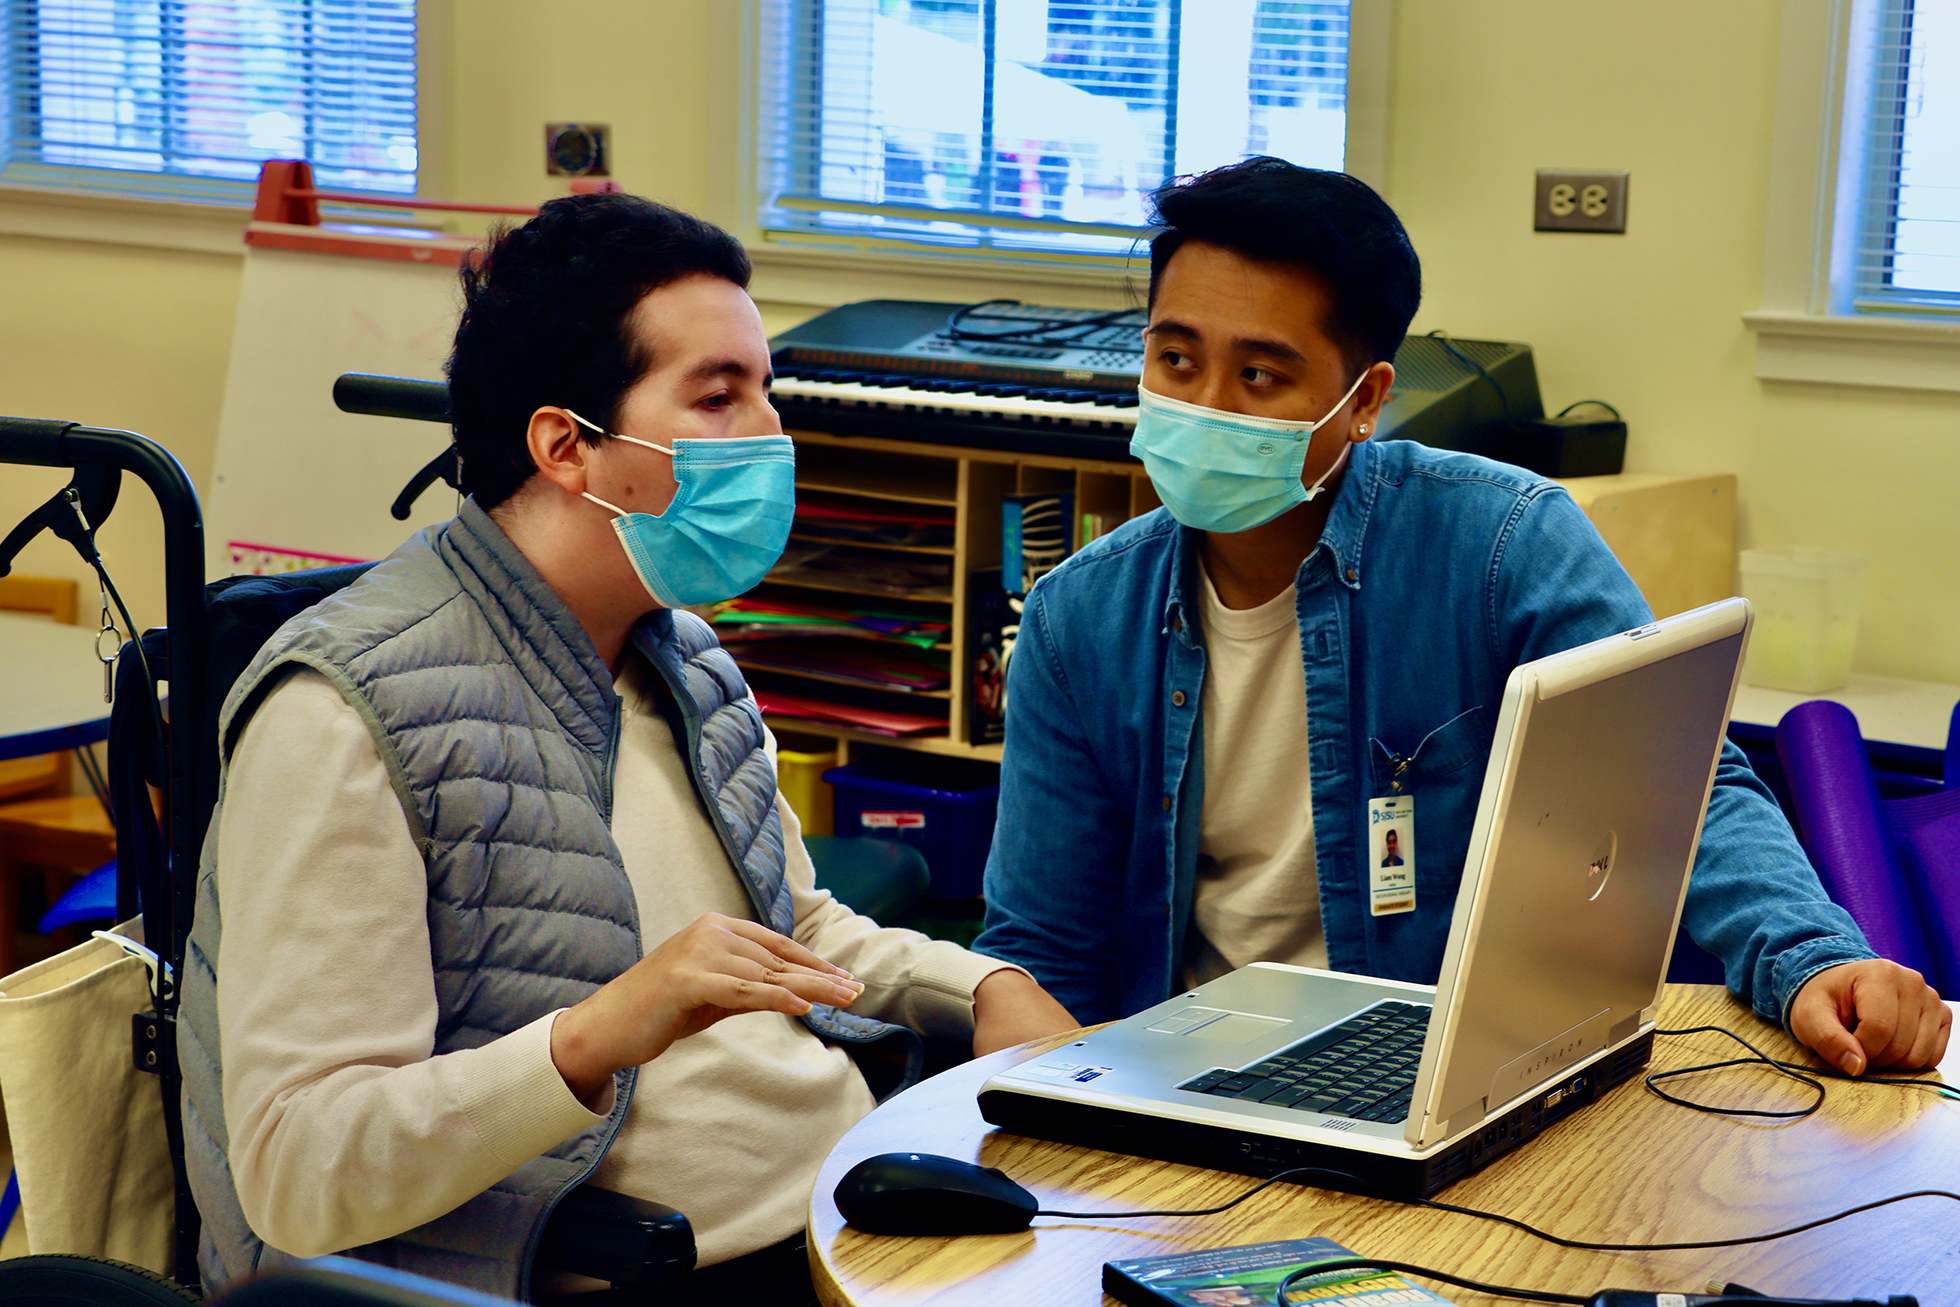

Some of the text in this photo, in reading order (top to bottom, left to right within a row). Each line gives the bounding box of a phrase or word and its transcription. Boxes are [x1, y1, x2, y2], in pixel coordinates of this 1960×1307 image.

[1588, 856, 1608, 877] DELL
[1520, 1038, 1582, 1080] INSPIRON
[1285, 1276, 1411, 1303] Review
